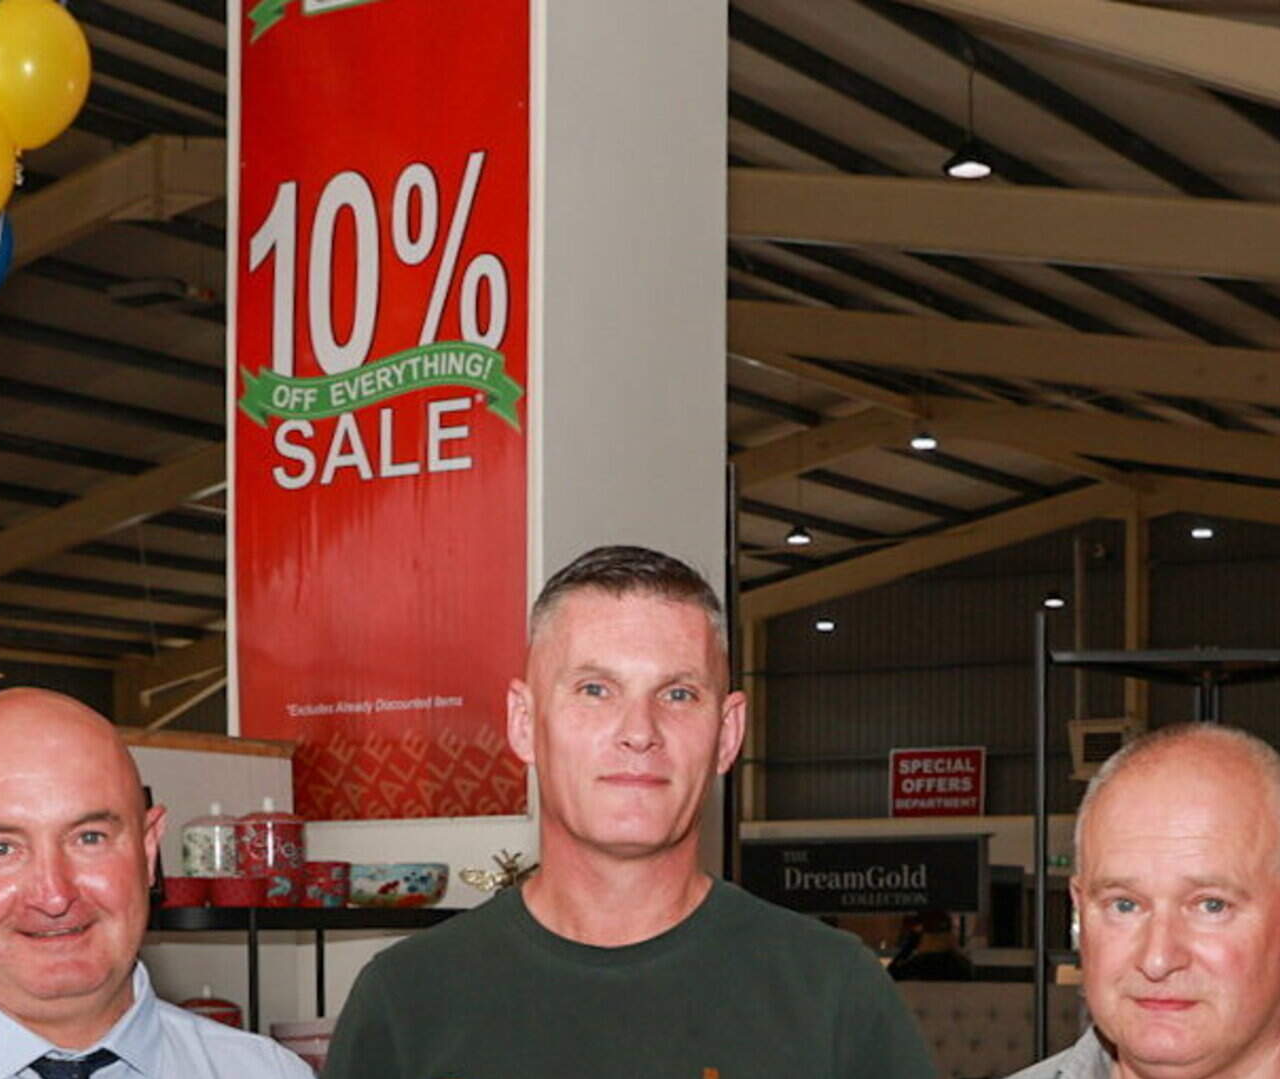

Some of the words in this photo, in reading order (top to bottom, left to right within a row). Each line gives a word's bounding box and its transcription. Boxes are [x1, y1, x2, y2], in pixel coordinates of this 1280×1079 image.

[249, 151, 509, 378] 10%
[272, 384, 317, 411] OFF
[329, 351, 494, 407] EVERYTHING!
[898, 757, 976, 775] SPECIAL
[901, 776, 972, 793] OFFERS
[895, 796, 977, 809] DEPARTMENT
[783, 863, 927, 890] DreamGold
